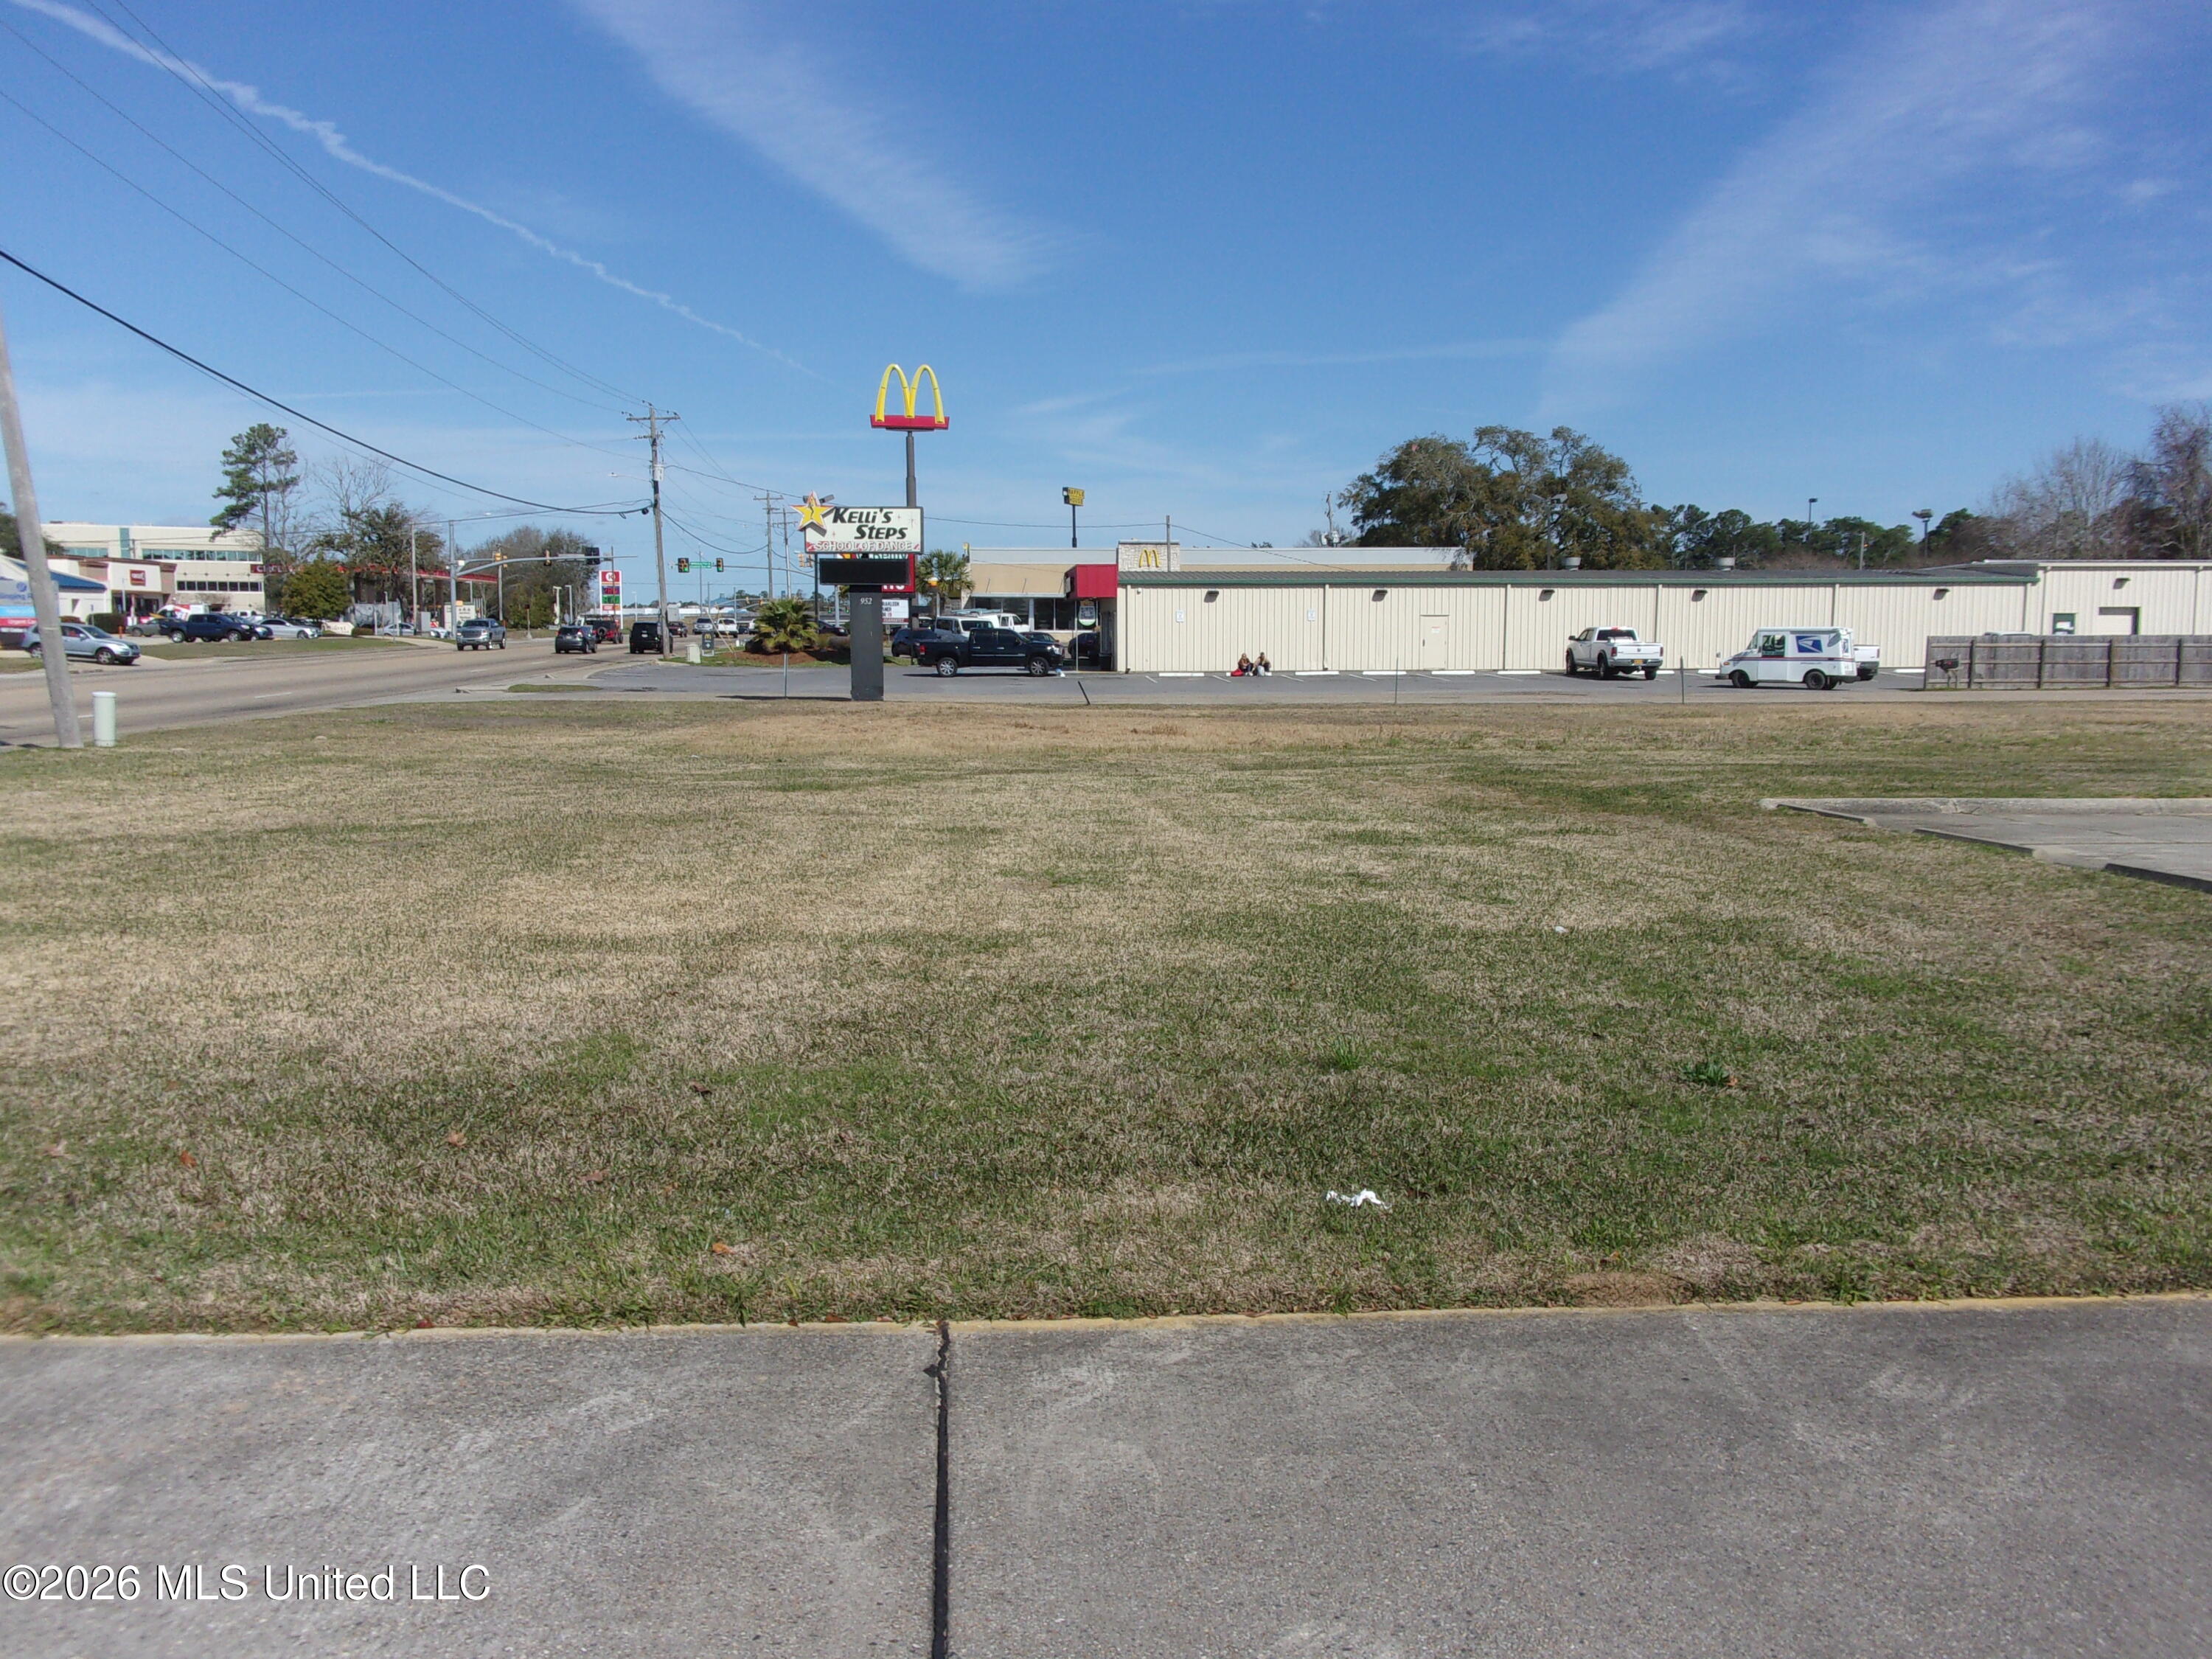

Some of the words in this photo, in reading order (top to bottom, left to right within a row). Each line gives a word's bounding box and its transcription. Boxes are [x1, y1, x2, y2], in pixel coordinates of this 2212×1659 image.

[815, 540, 859, 551] SCHOOL
[862, 541, 875, 551] OF
[878, 541, 912, 551] DANCE
